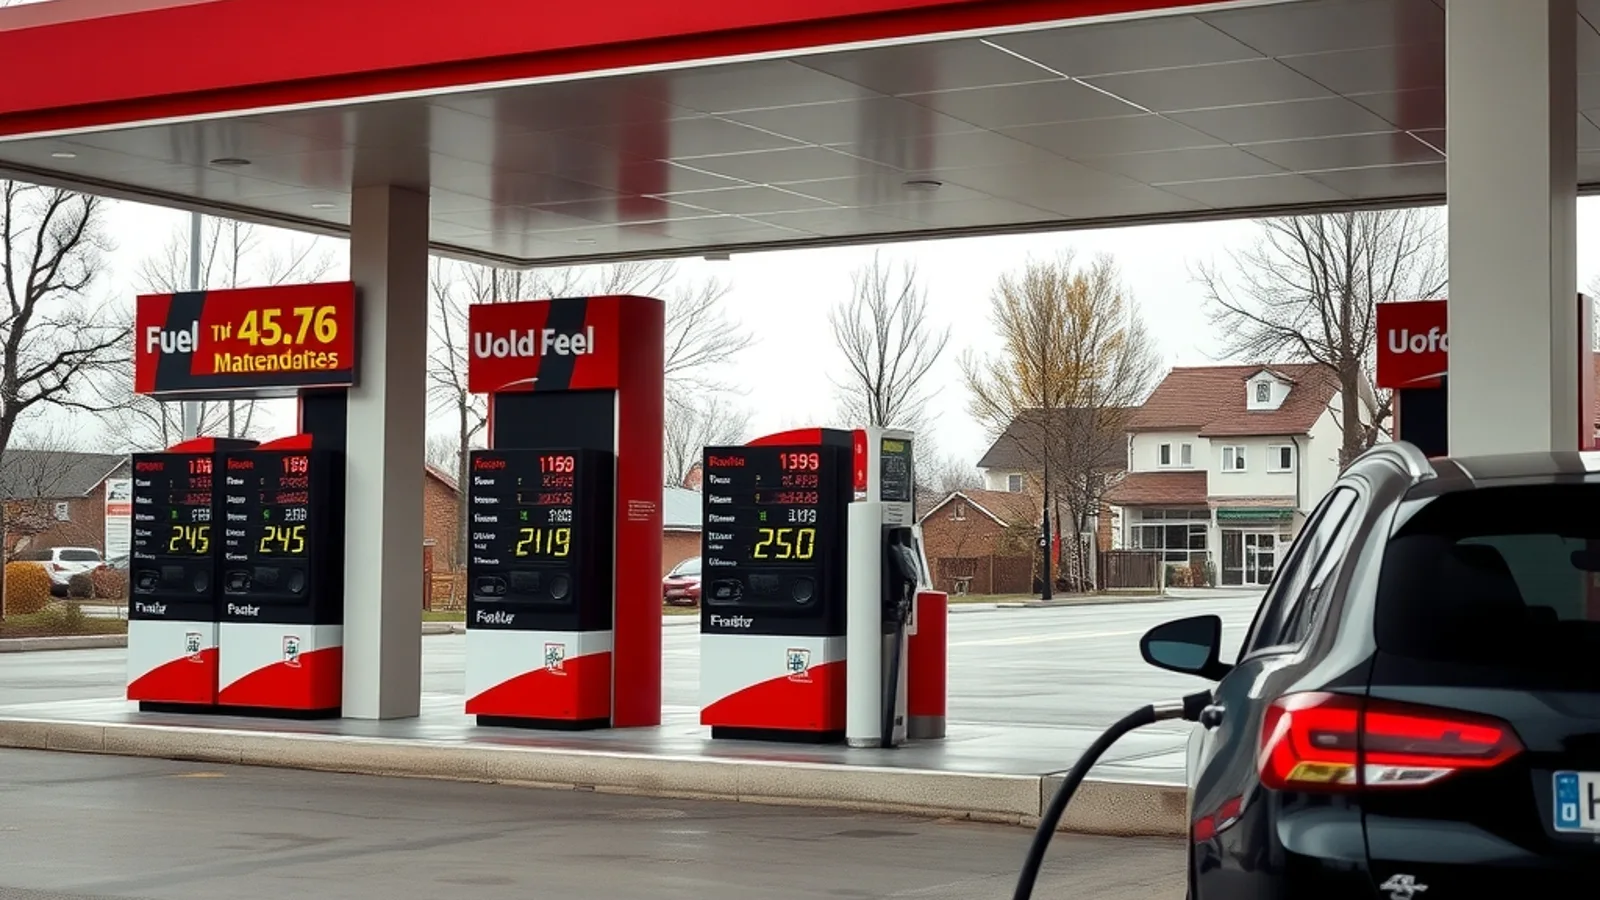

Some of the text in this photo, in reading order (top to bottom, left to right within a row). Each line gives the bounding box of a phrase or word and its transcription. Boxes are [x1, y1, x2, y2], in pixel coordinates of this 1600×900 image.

[146, 320, 199, 354] Fuel
[237, 305, 338, 346] 45.76
[474, 325, 595, 358] Uold Feel
[169, 525, 211, 553] 245
[259, 524, 306, 553] 245
[515, 527, 571, 557] 2119
[753, 527, 816, 559] 25.0
